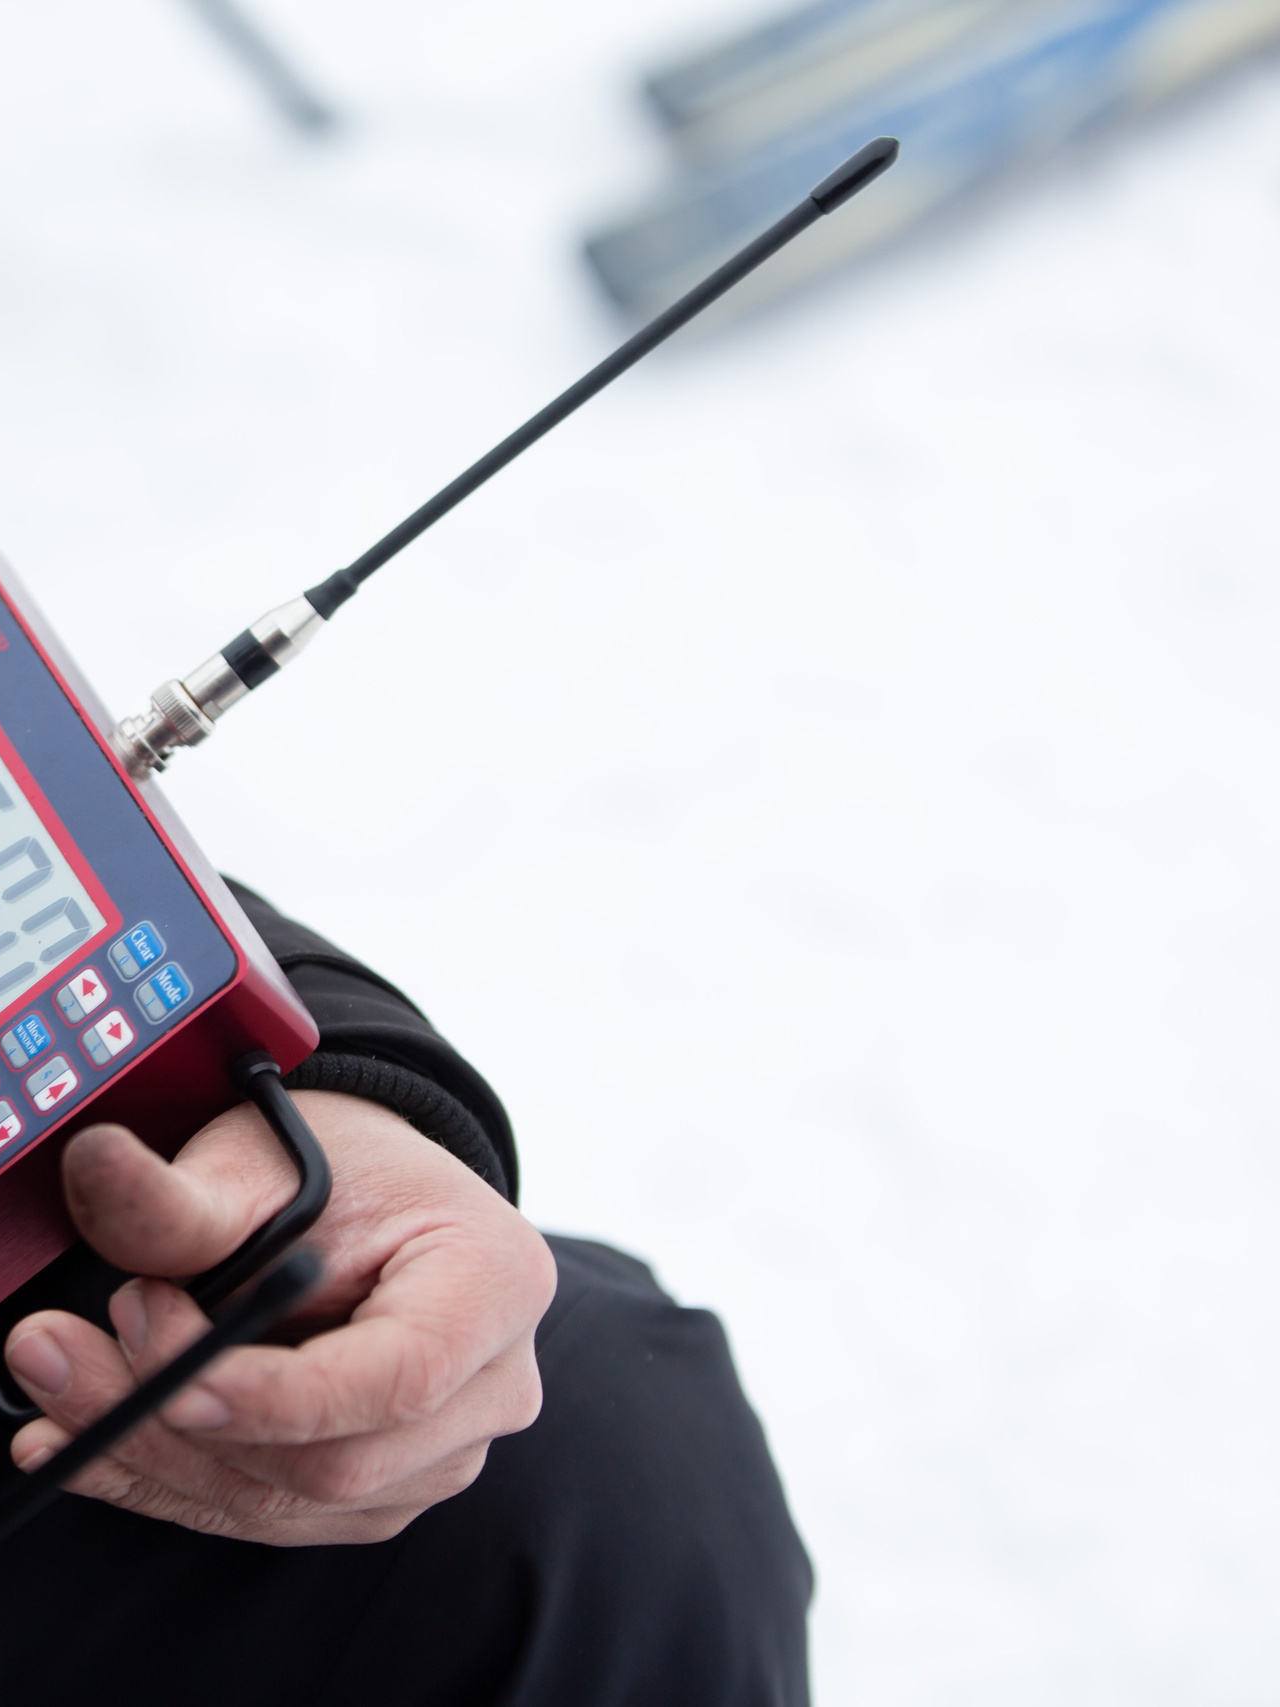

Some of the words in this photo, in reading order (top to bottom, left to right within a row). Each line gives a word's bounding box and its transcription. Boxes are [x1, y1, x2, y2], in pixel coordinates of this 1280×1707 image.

[130, 928, 156, 962] Clear
[155, 968, 181, 1005] Mode
[15, 1024, 37, 1056] WINDOW
[25, 1019, 45, 1047] Block
